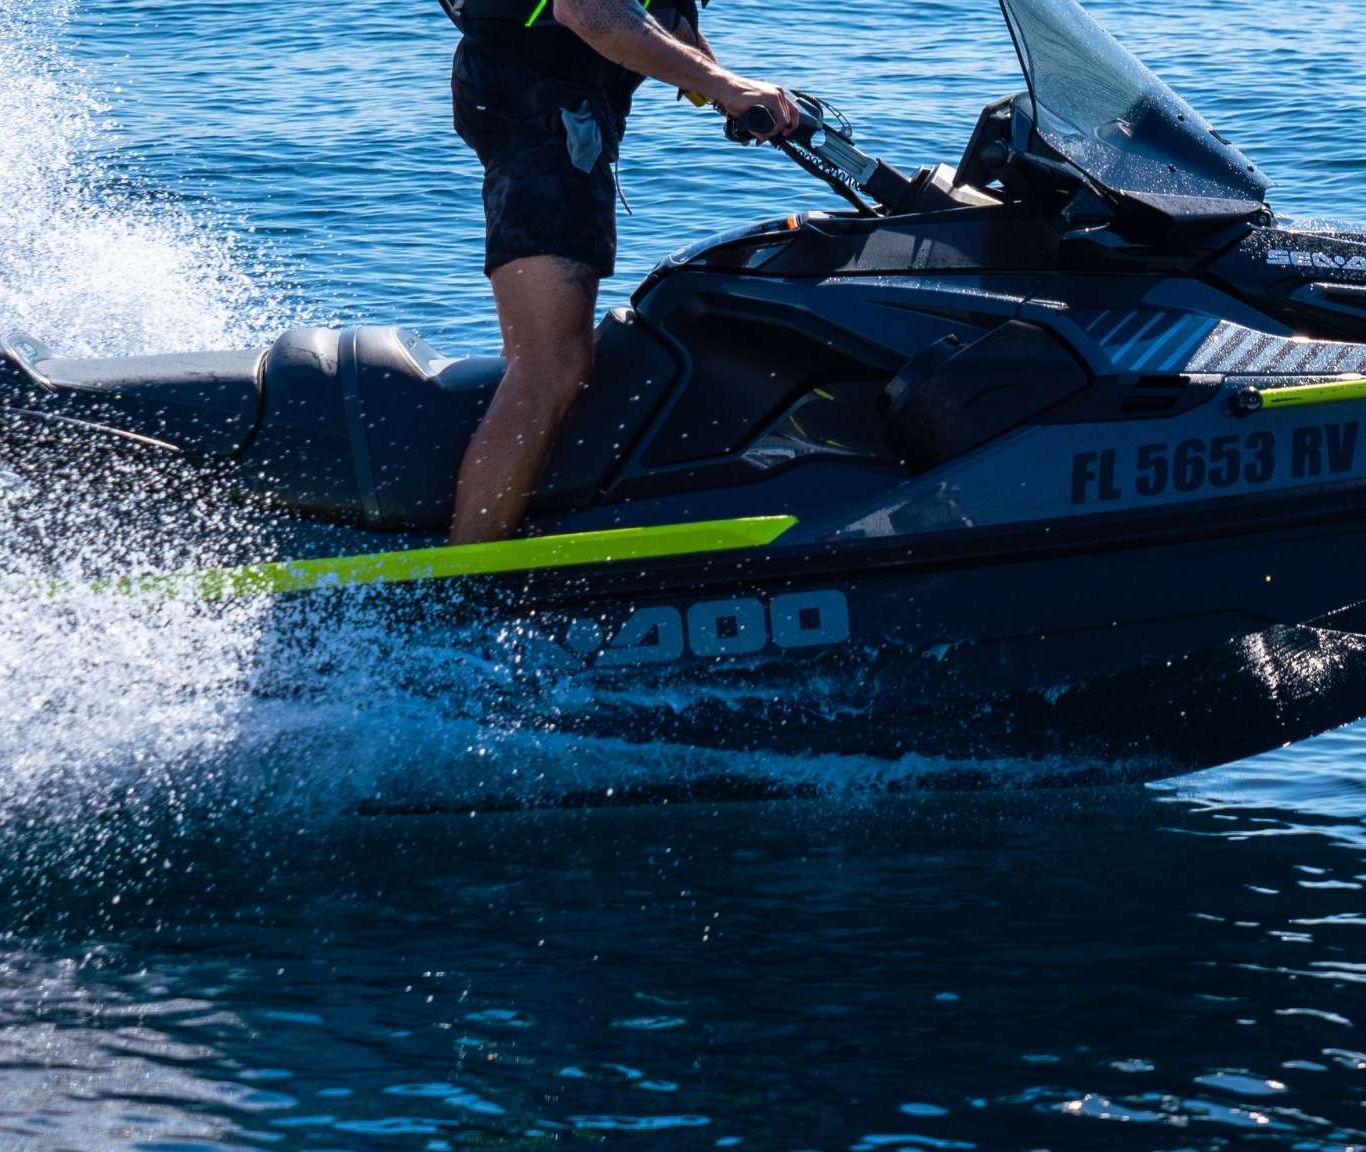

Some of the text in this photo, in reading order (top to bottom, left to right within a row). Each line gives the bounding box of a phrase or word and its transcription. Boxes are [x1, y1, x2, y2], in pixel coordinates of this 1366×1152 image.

[1070, 420, 1360, 504] FL 5653 RV
